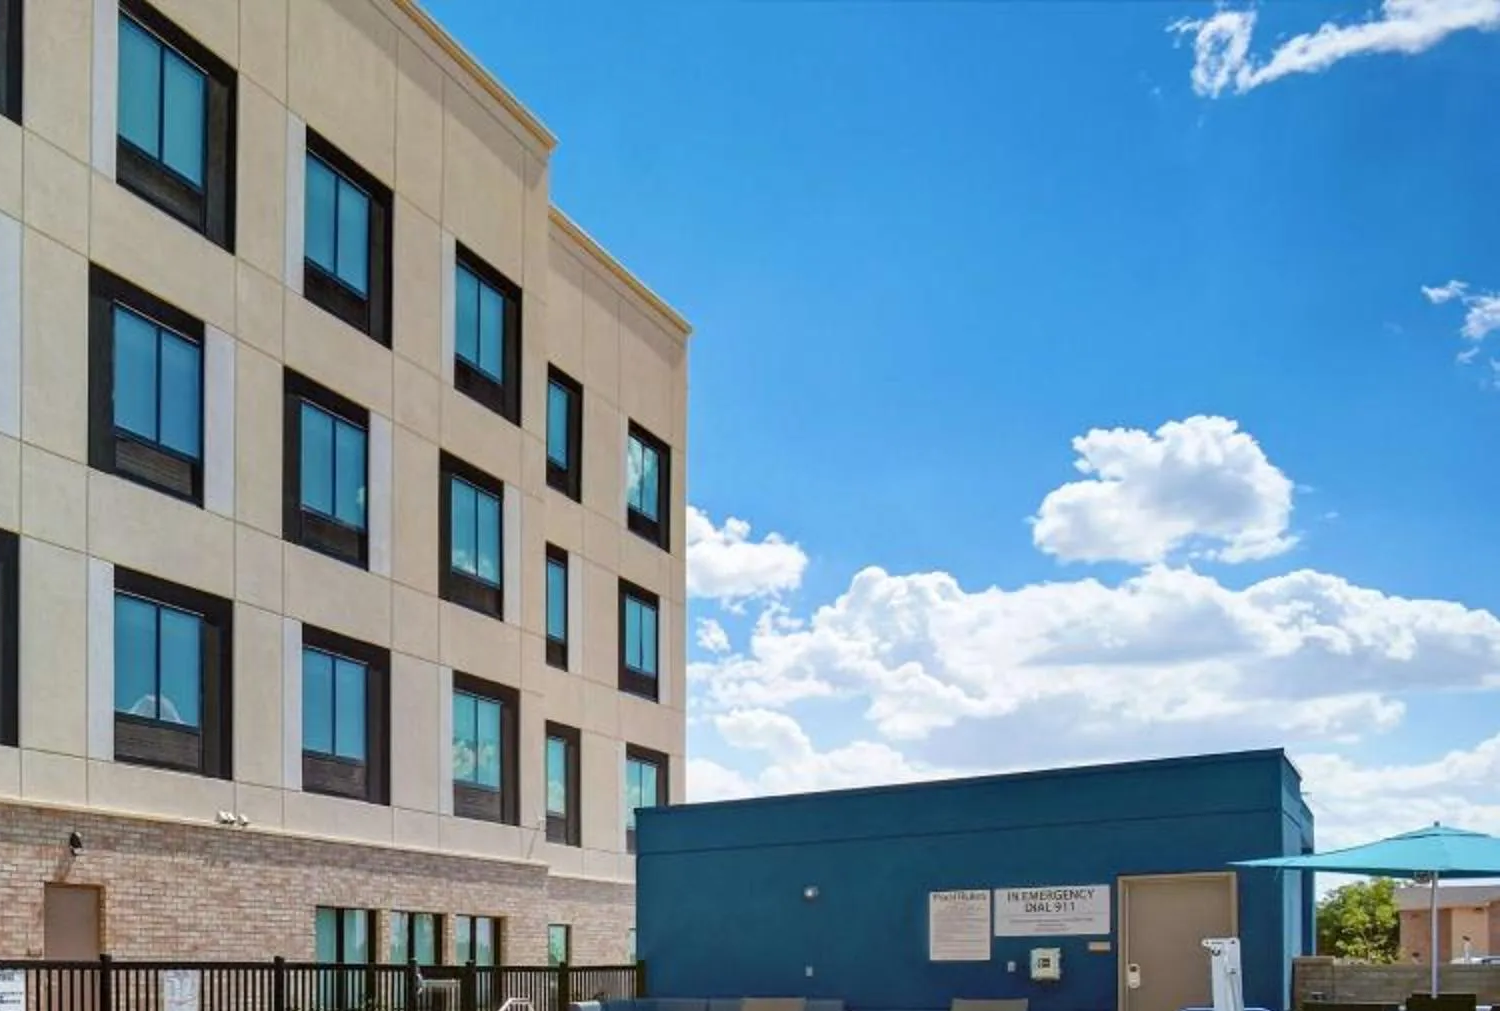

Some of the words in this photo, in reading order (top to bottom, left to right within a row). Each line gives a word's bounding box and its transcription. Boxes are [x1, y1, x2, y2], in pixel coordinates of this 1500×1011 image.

[1008, 892, 1019, 902] IN
[1020, 890, 1095, 901] EMERGENCY
[1025, 902, 1051, 913] DIAL
[1055, 902, 1075, 912] 911
